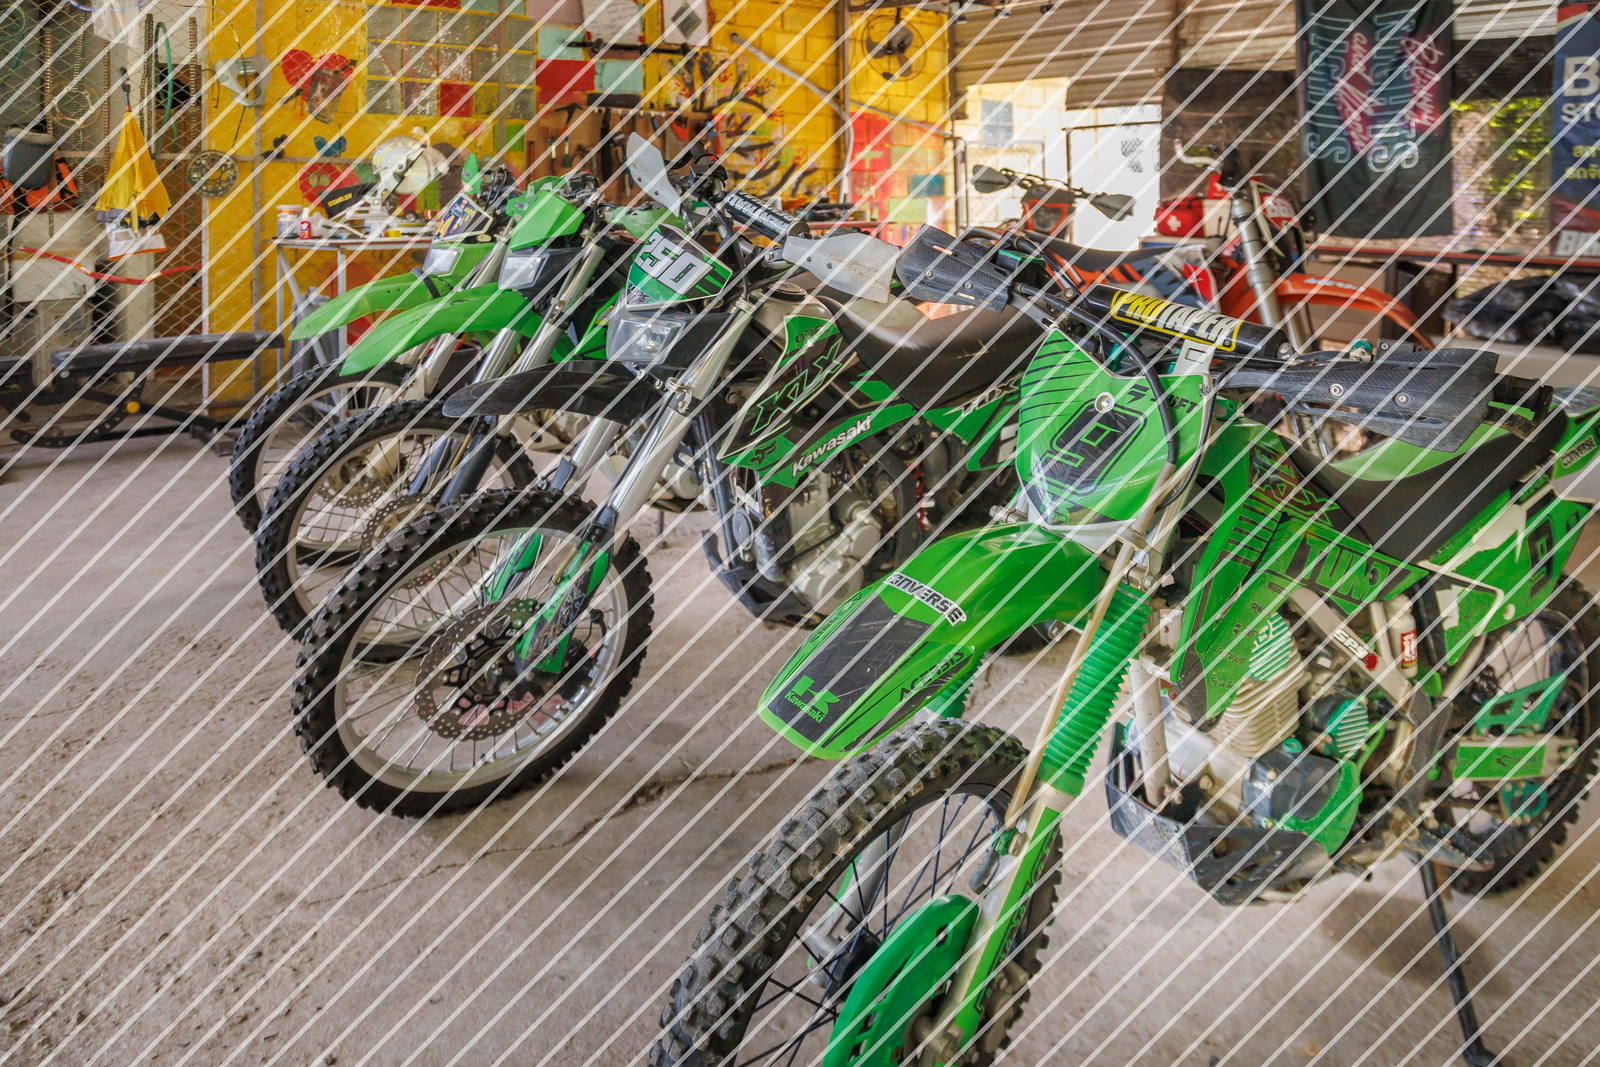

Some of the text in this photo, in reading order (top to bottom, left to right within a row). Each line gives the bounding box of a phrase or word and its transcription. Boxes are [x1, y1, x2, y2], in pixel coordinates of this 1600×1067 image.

[1349, 32, 1374, 84] and
[1305, 12, 1354, 164] LIGHTS
[1366, 9, 1419, 173] NIGHTS
[634, 231, 714, 295] 250
[1115, 292, 1236, 347] PROTAPER
[750, 337, 843, 436] KLX
[792, 415, 872, 478] Kawasaki
[1332, 628, 1369, 659] SPY
[899, 651, 965, 702] ACERBIS
[783, 690, 826, 724] Kawasaki
